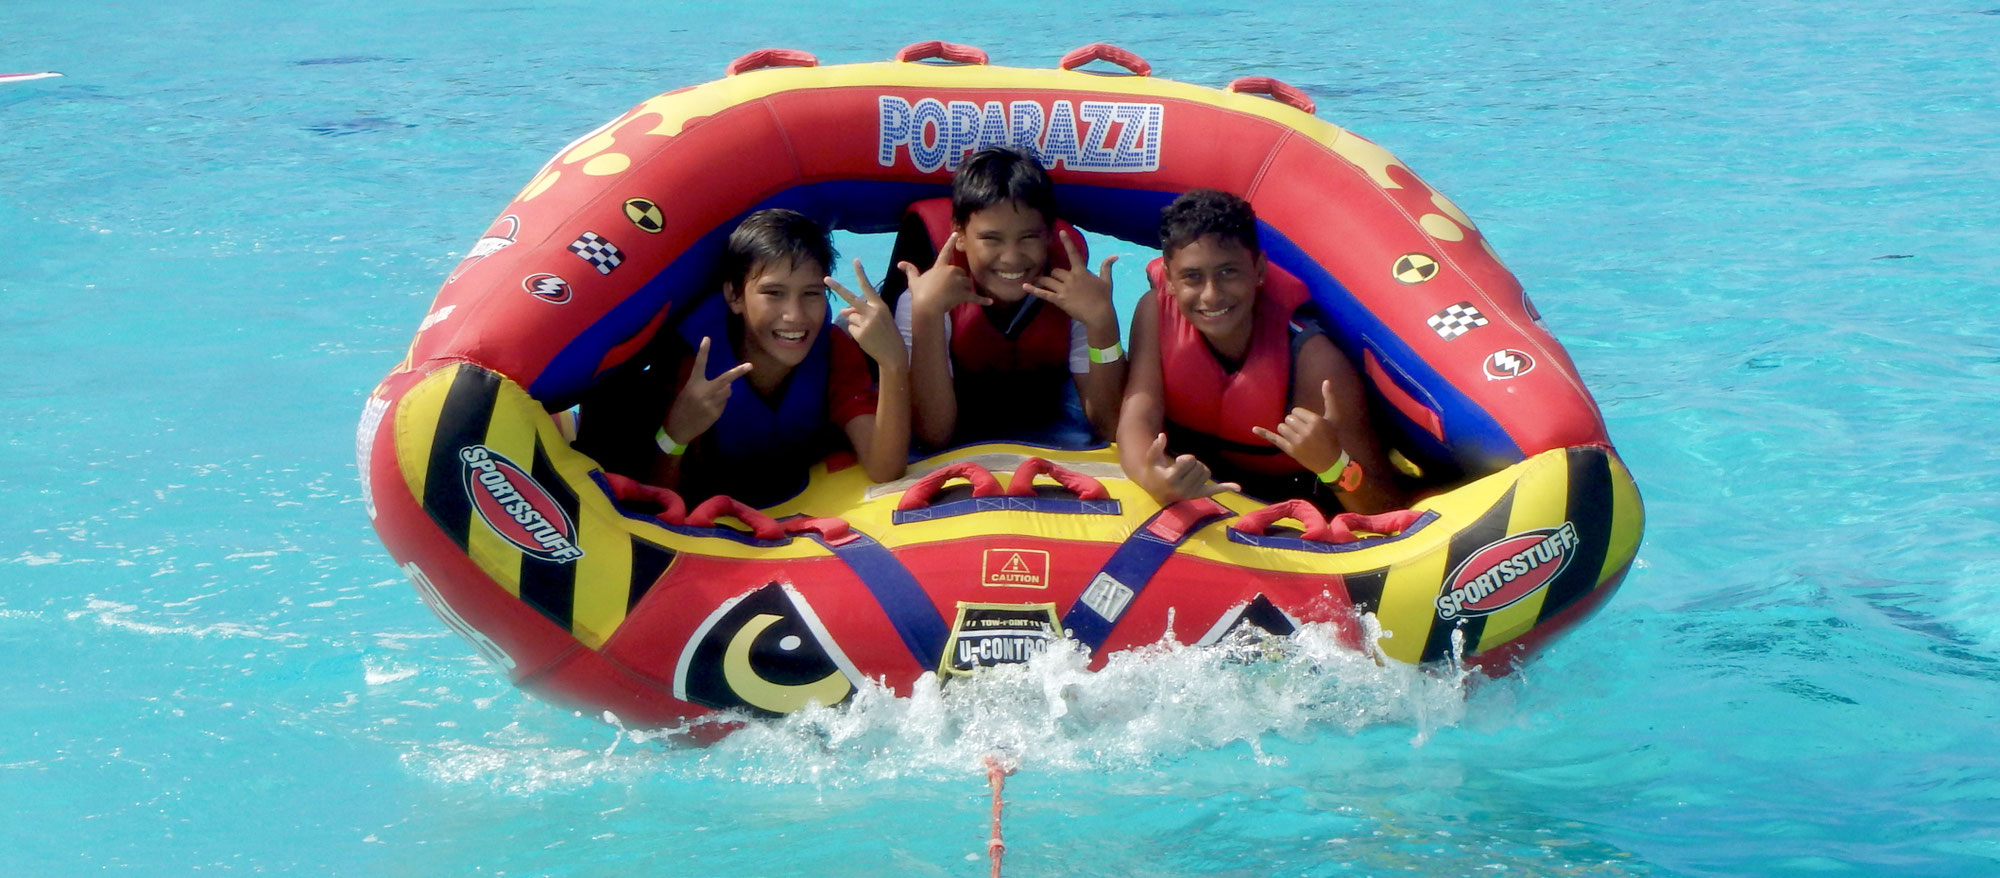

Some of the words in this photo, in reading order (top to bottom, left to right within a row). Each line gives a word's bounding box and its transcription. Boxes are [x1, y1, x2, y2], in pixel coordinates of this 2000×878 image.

[878, 95, 1165, 174] POPARAZZI
[462, 446, 583, 560] SPORTSSTUFF
[991, 573, 1040, 584] CAUTION
[1437, 524, 1576, 618] SPORTSSTUFF
[959, 637, 1047, 662] U-CONTRO
